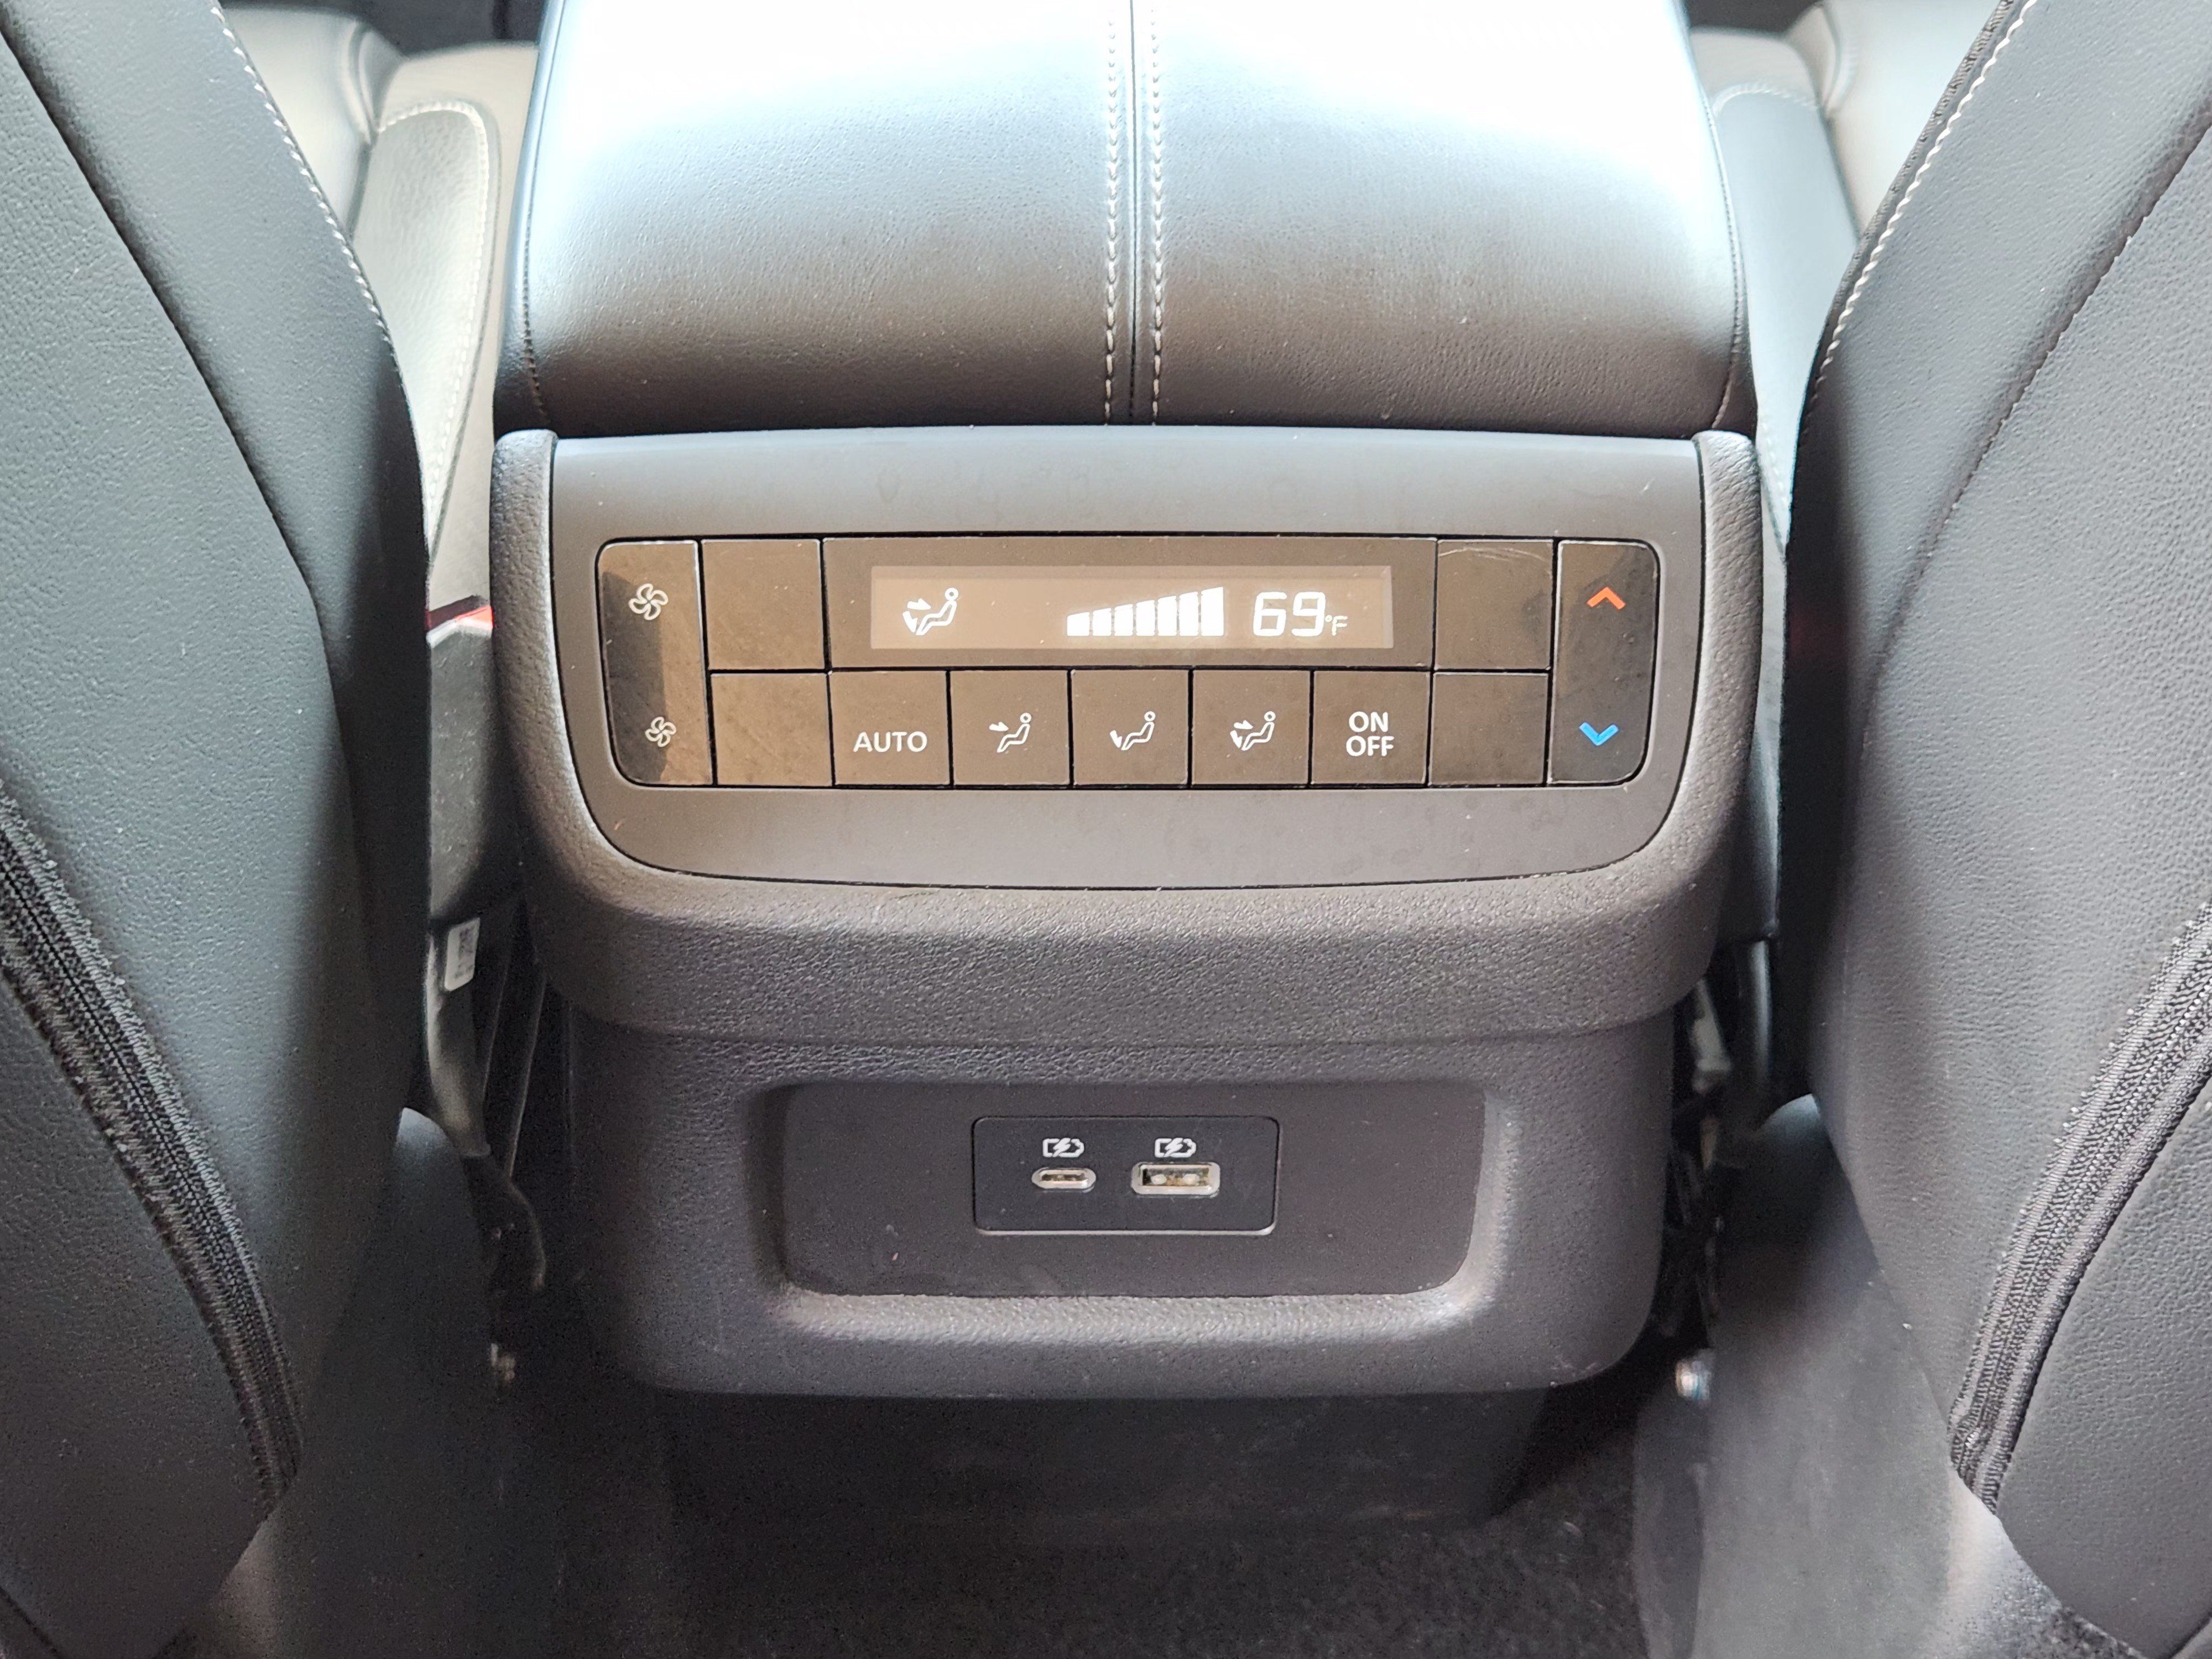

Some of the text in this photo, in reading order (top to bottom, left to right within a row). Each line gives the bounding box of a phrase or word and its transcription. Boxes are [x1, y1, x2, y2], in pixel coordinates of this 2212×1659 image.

[1348, 711, 1389, 733] ON
[853, 731, 928, 753] AUTO
[1345, 734, 1395, 757] OFF
